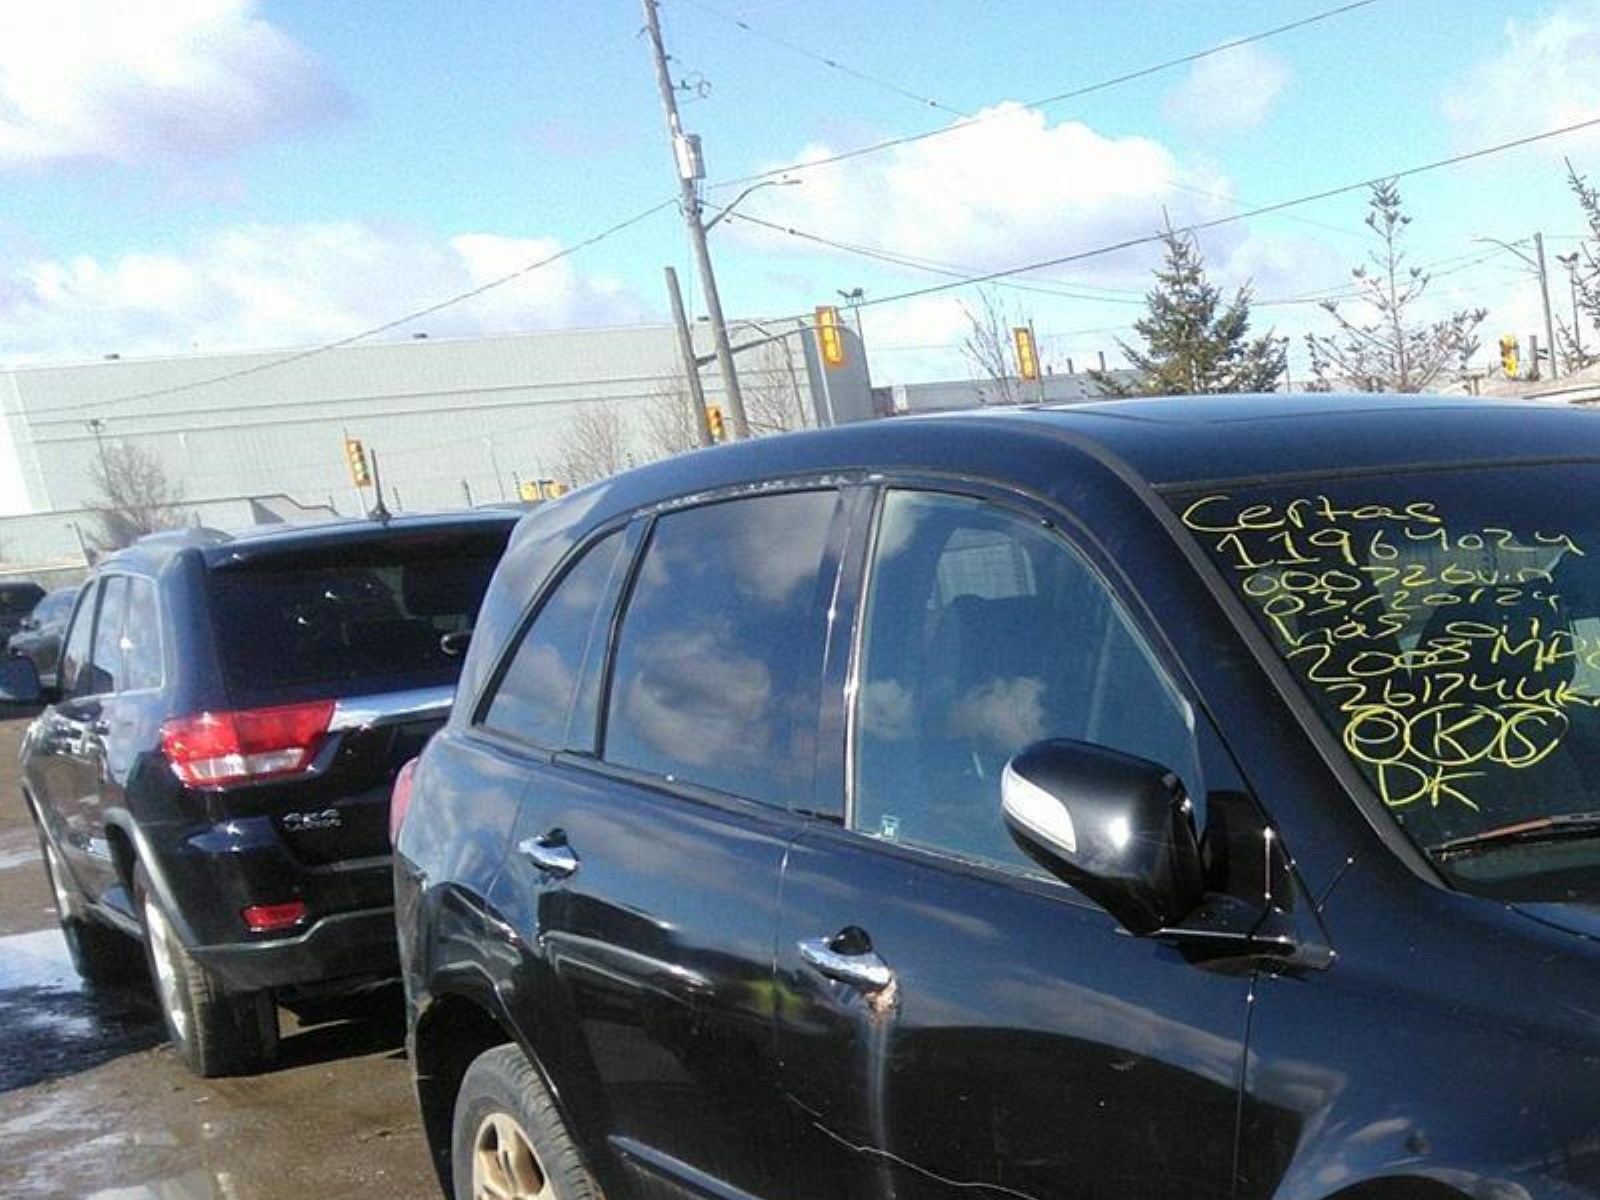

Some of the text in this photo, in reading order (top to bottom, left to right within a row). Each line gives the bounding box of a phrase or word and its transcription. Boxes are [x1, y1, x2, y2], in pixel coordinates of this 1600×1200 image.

[1216, 527, 1585, 569] 11964024
[1285, 638, 1471, 683] 2008
[1377, 761, 1488, 812] DK
